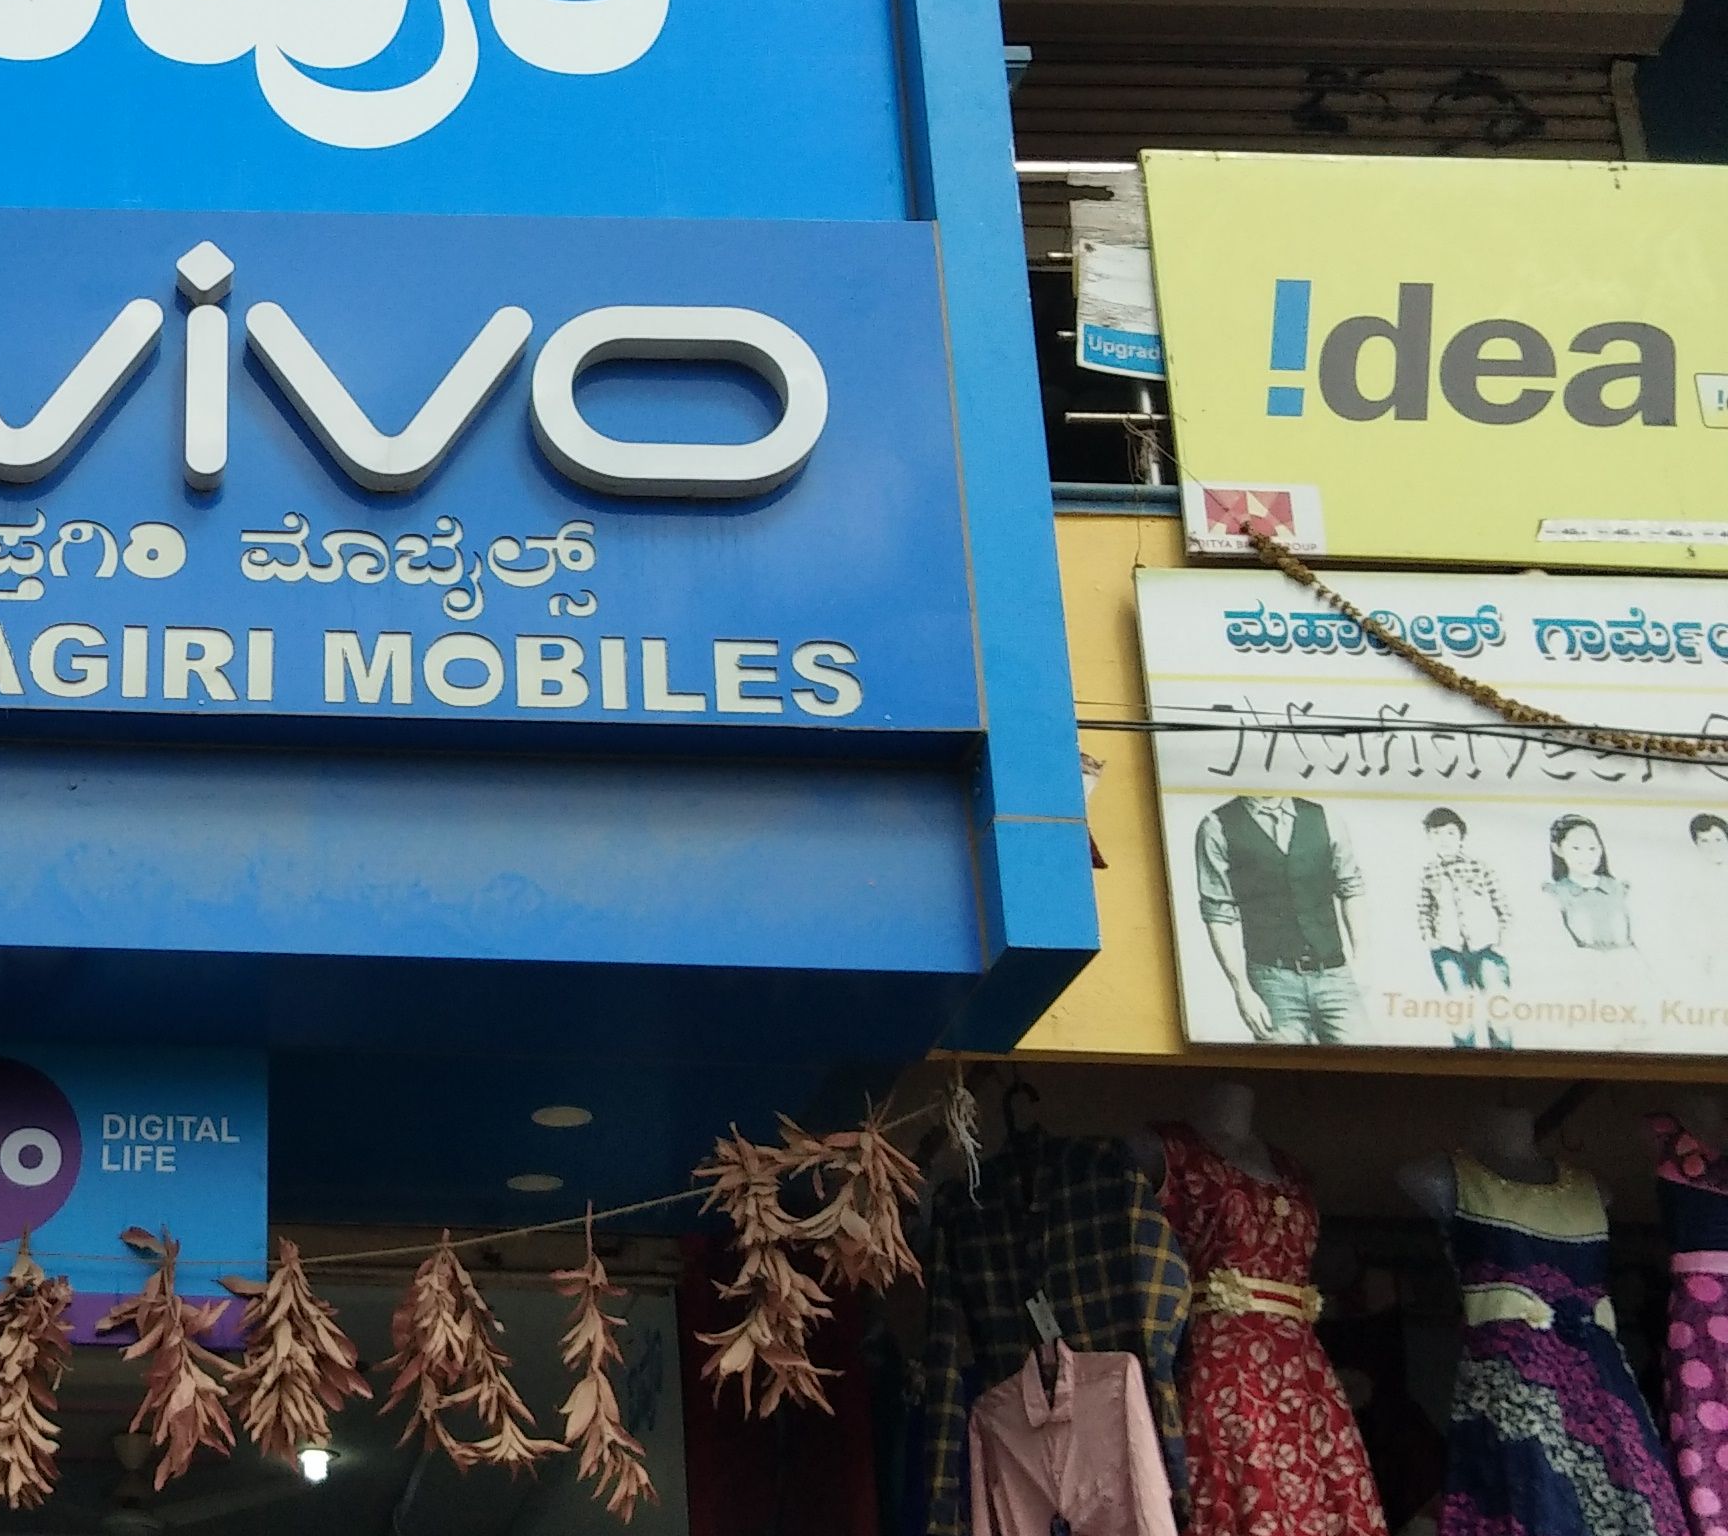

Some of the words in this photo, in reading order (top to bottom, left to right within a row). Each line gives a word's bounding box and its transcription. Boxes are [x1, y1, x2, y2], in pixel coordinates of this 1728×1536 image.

[323, 630, 865, 717] MOBILES
[1382, 992, 1474, 1026] Tangi
[101, 1112, 242, 1144] DIGITAL
[101, 1144, 177, 1172] LIFE
